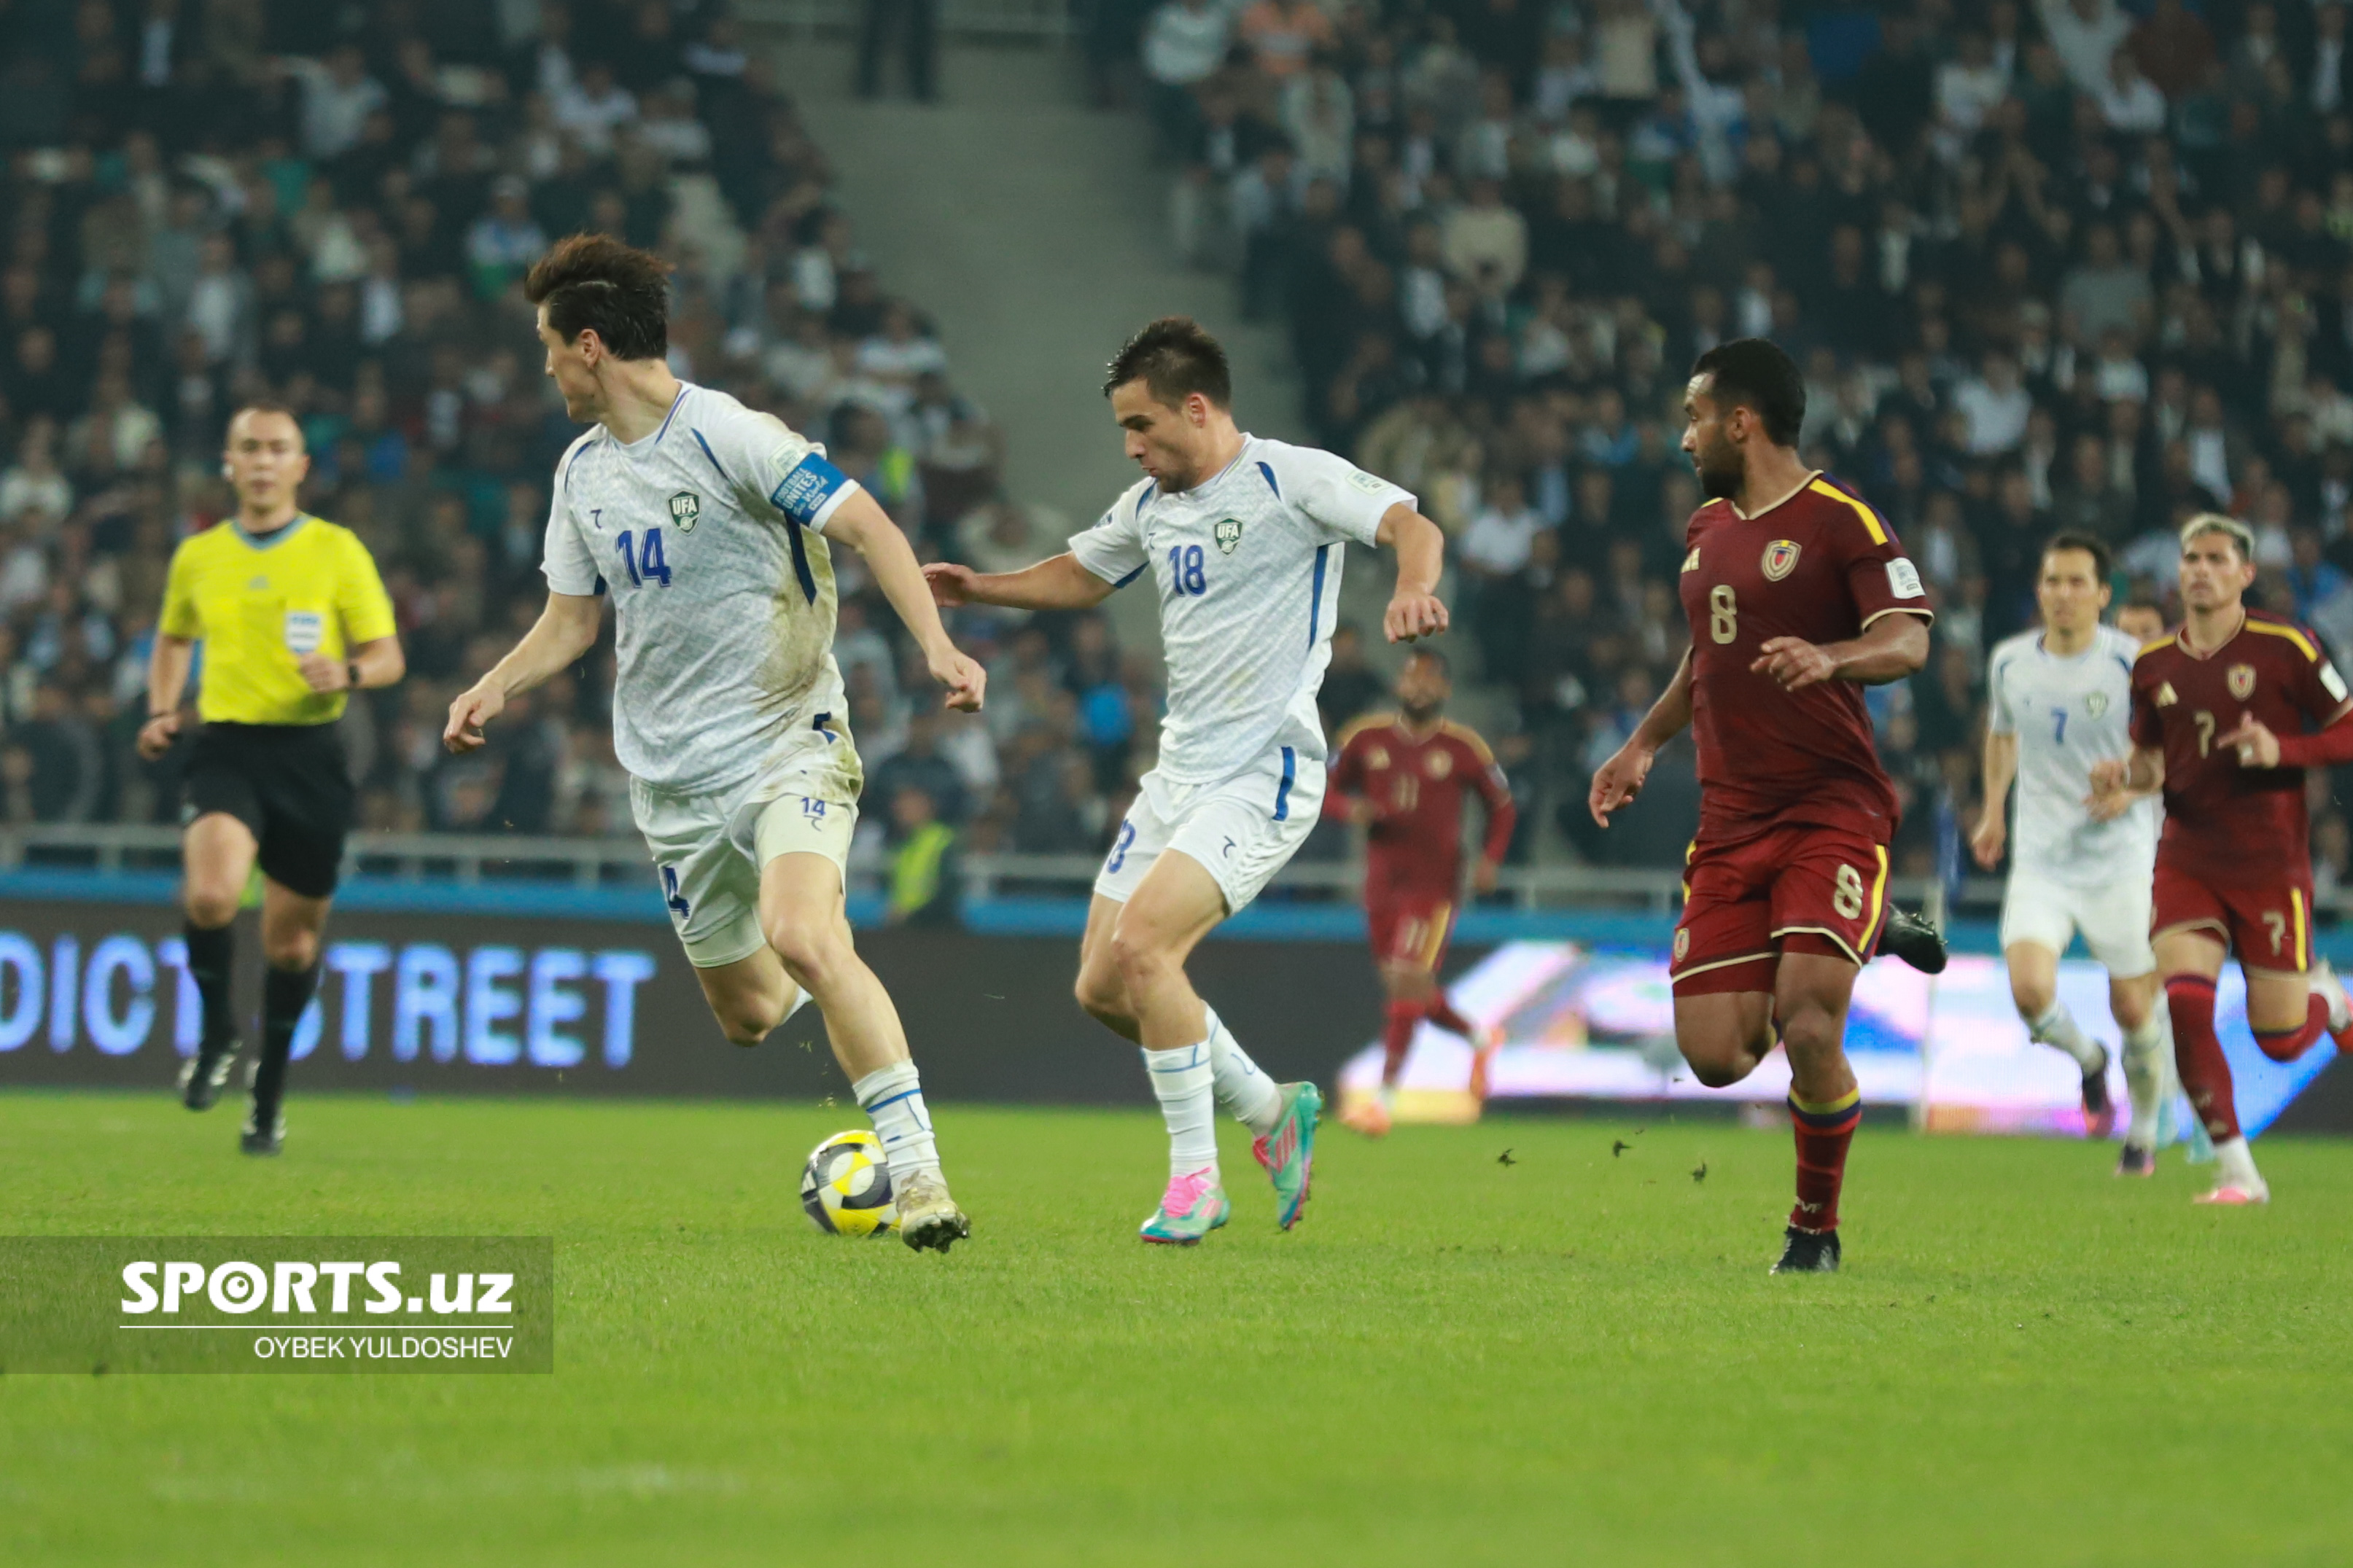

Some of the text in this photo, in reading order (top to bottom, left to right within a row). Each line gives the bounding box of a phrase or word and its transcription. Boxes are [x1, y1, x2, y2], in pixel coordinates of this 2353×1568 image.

[774, 467, 807, 502] FOOTBALL
[782, 472, 817, 509] UNITES
[672, 497, 698, 515] UFA
[1217, 524, 1239, 539] UFA
[615, 528, 672, 588] 14
[1169, 545, 1207, 597] 18
[1710, 585, 1737, 644] 8
[2050, 707, 2068, 745] 7
[2195, 710, 2216, 759] 7
[801, 797, 826, 816] 14
[1833, 864, 1863, 920] 8
[2263, 911, 2286, 956] 7
